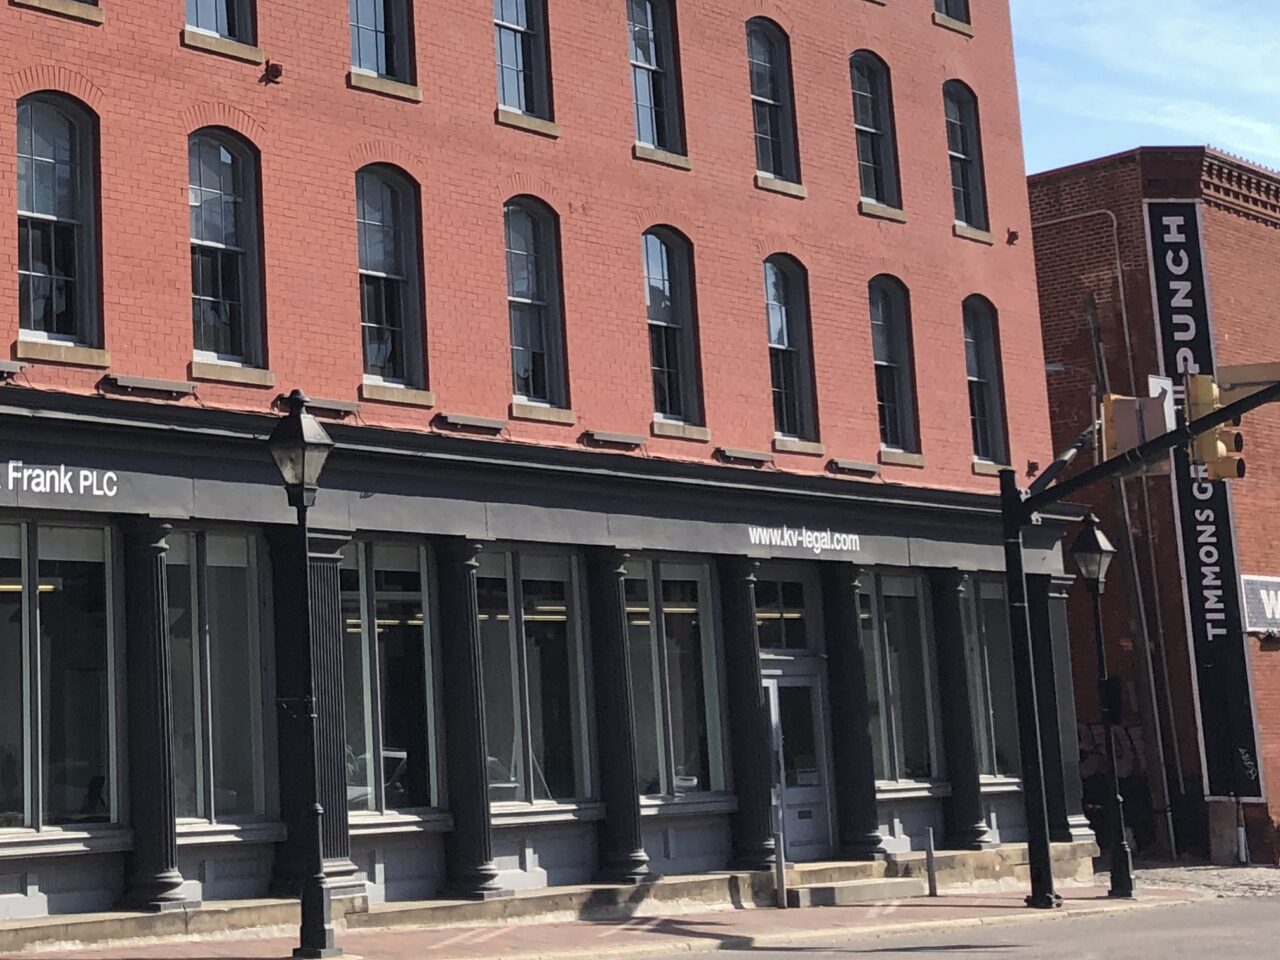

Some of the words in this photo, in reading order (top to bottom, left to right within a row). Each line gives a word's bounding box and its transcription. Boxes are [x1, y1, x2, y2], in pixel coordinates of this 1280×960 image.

[1162, 216, 1200, 375] PUNCH
[8, 460, 74, 494] Frank
[79, 470, 118, 497] PLC
[748, 525, 860, 554] www.kv-legal.com
[1195, 509, 1227, 641] TIMMONS
